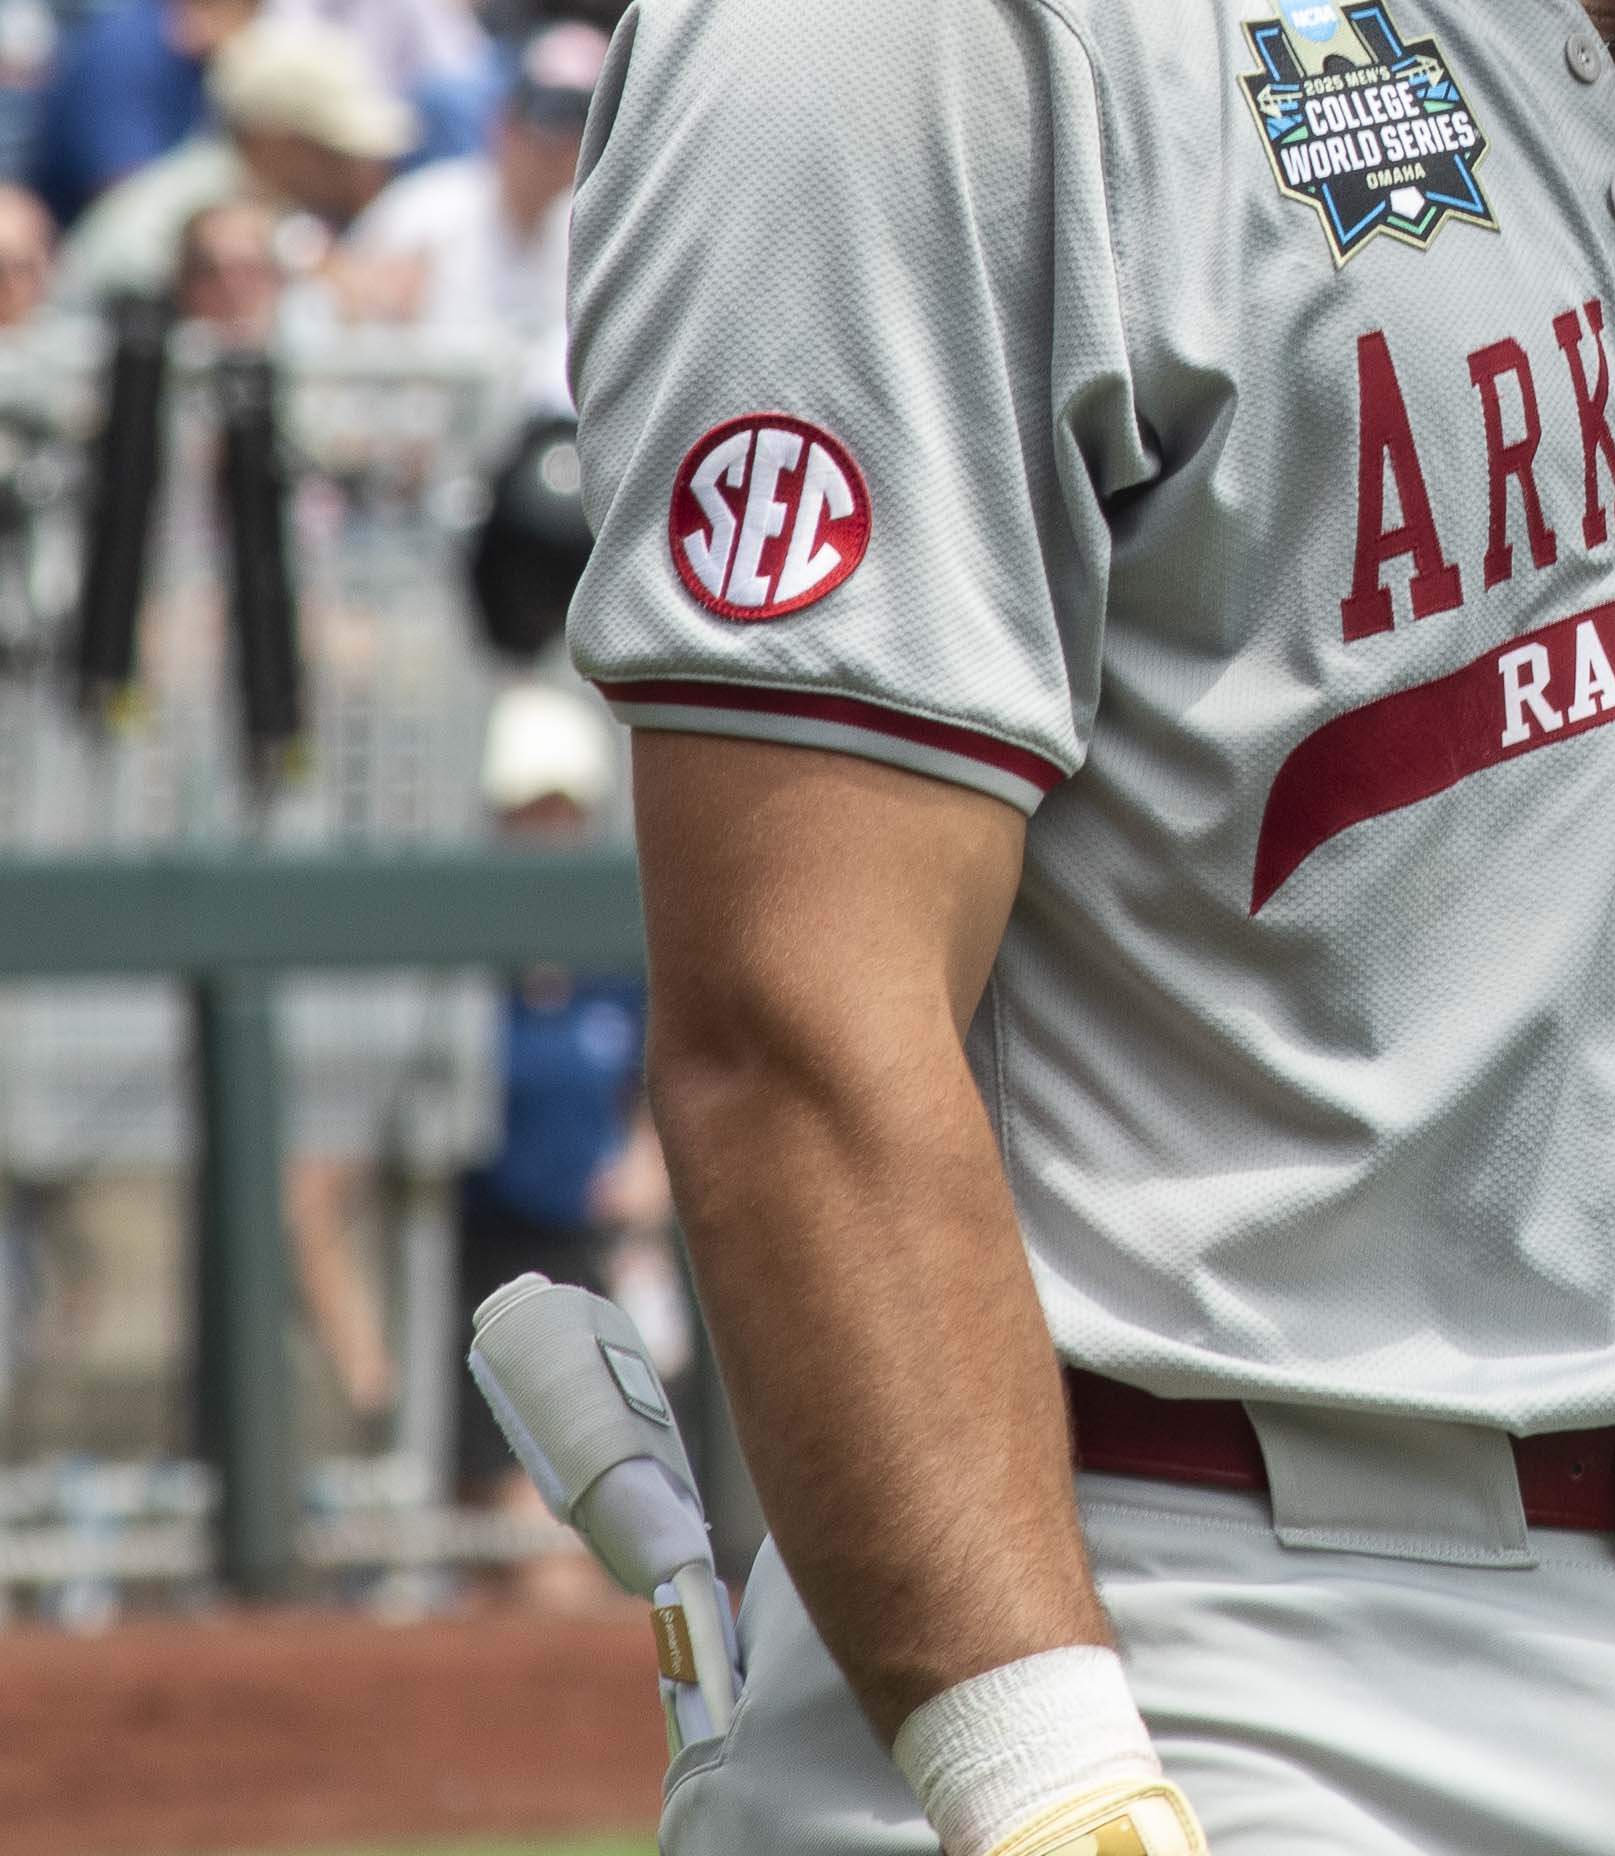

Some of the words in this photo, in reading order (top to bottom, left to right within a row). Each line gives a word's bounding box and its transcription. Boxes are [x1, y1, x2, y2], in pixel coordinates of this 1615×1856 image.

[1304, 72, 1344, 97] 2025
[1345, 64, 1391, 89] MEN'S
[1304, 81, 1420, 137] COLLEGE
[1280, 129, 1383, 186] WORLD
[1380, 111, 1476, 162] SERIES
[1366, 162, 1426, 190] OMAHA
[683, 428, 855, 607] SEC
